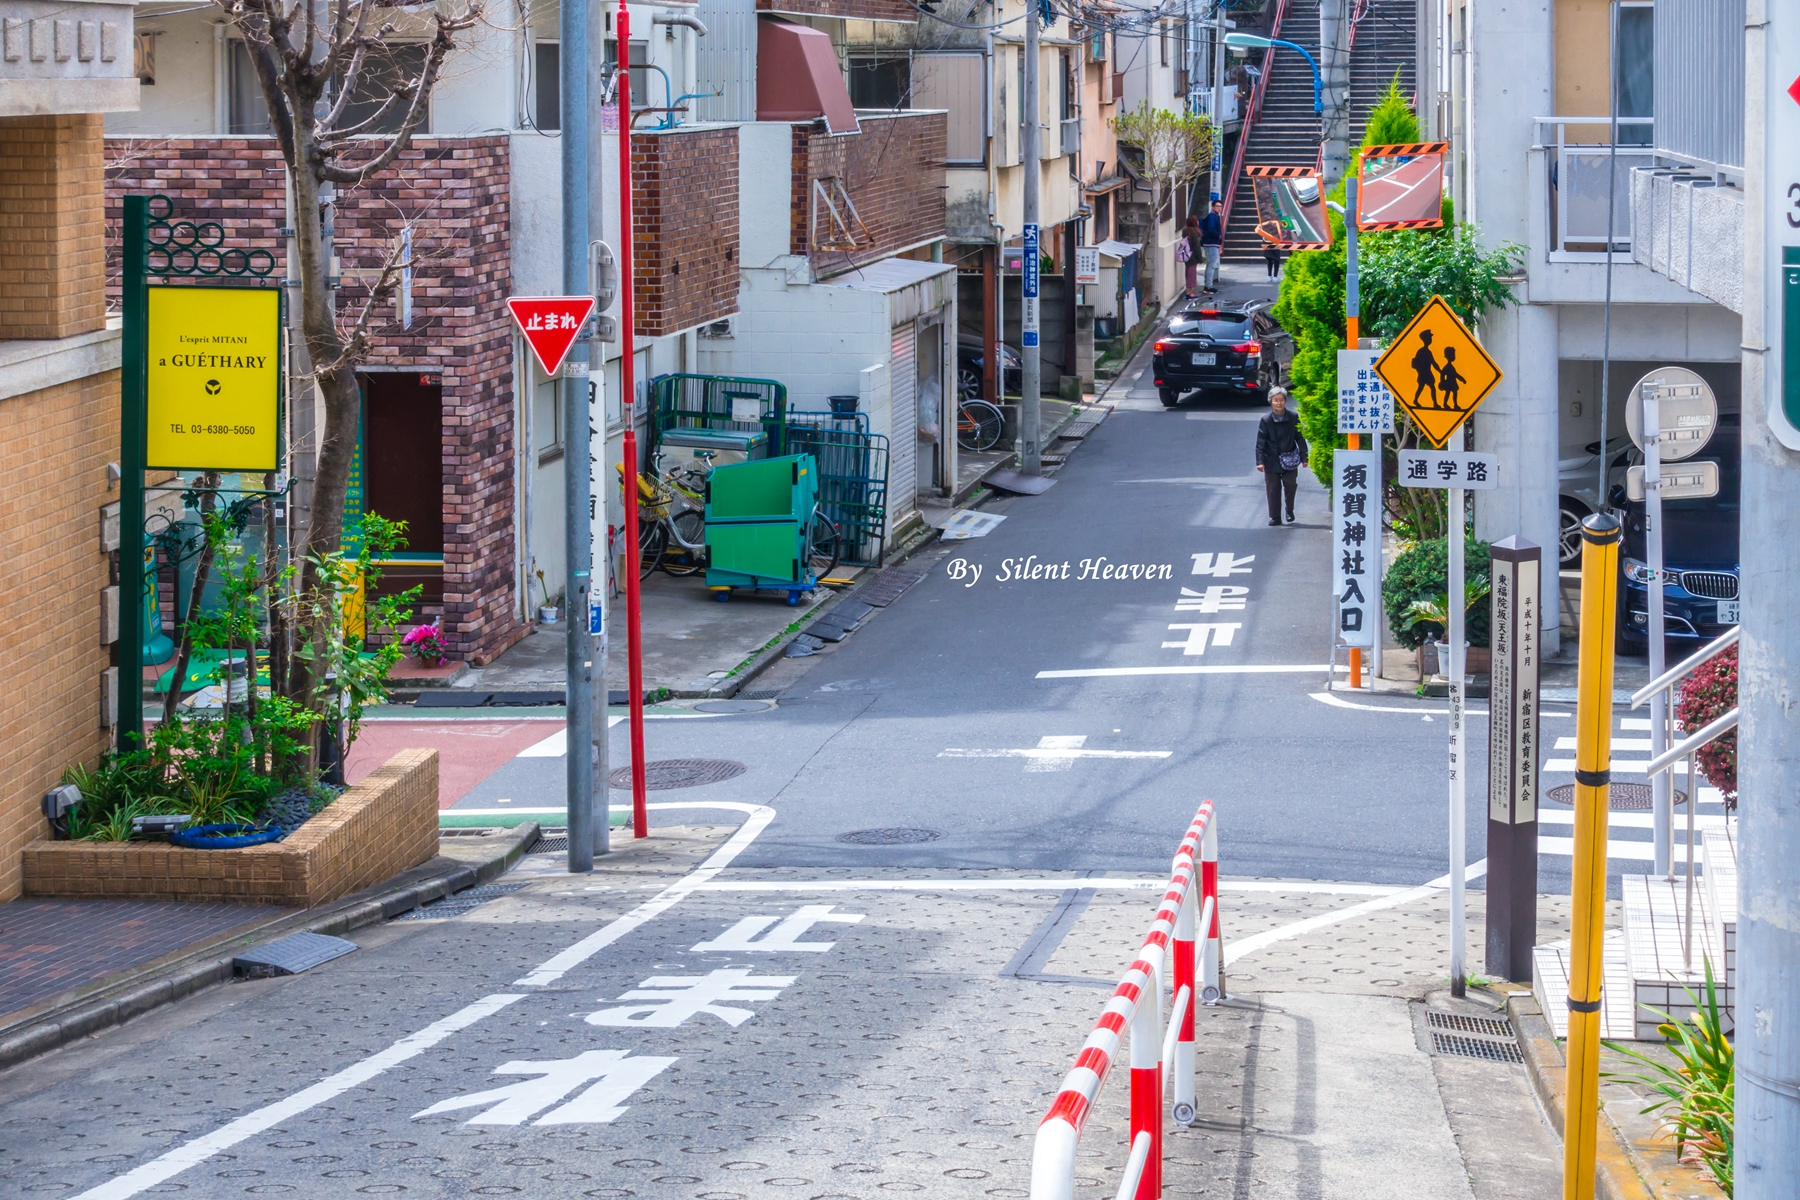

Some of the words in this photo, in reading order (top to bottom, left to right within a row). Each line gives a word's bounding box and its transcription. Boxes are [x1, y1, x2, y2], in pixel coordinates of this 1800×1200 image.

[179, 335, 210, 345] L'esprit
[212, 336, 248, 344] MITANI
[525, 312, 578, 331] 止まれ
[159, 357, 167, 366] a
[172, 351, 267, 369] GUÉTHARY
[1357, 369, 1367, 430] 出来ません
[170, 423, 186, 434] TEL
[191, 424, 255, 435] 03-6380-5050
[1407, 458, 1488, 482] 通学路
[1340, 463, 1367, 632] 須賀神社入口
[1524, 596, 1532, 667] 平成十年十月
[1521, 688, 1532, 802] 新宿区教育委員会
[409, 904, 866, 1127] 止まれ
